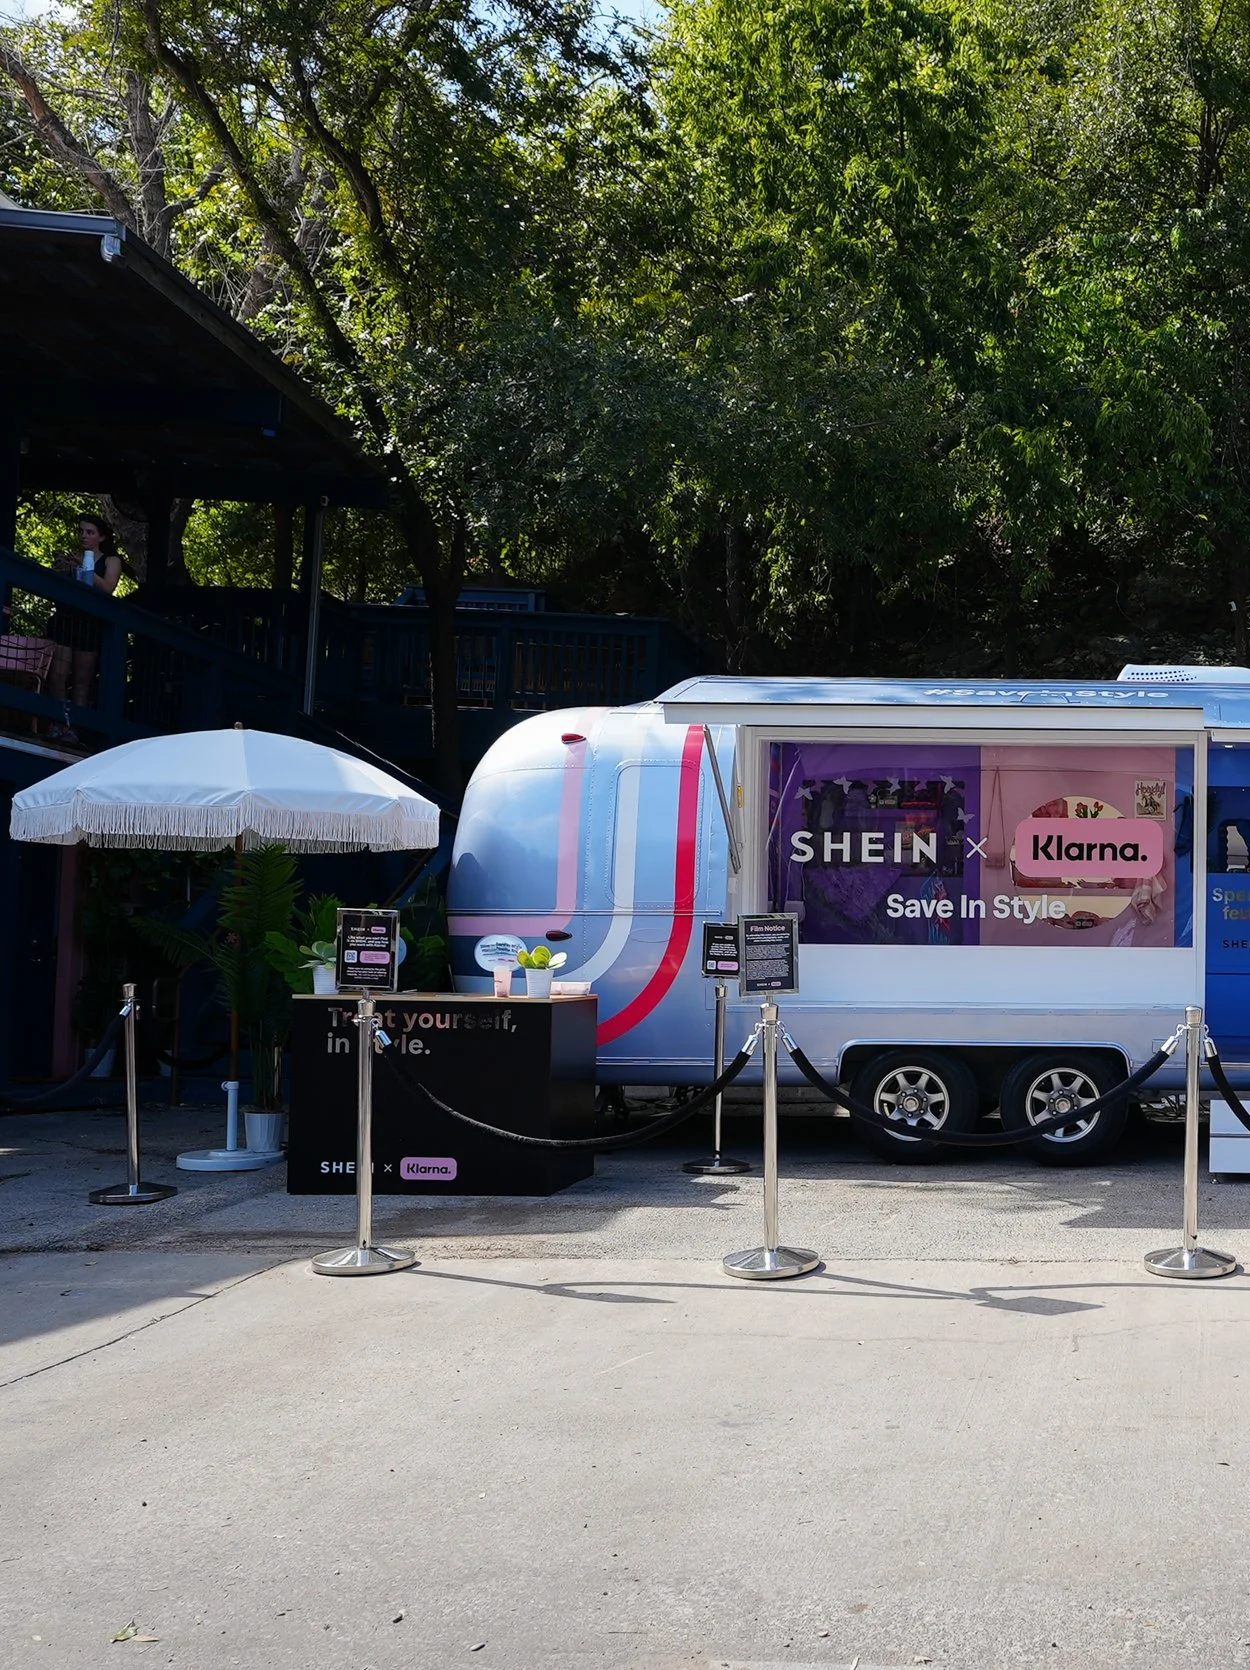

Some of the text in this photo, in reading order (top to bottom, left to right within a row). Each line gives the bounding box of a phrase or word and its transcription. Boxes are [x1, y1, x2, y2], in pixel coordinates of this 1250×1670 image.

[790, 831, 937, 863] SHEIN
[1032, 834, 1148, 862] Klarna.
[886, 894, 1067, 925] Save In Style
[403, 1005, 517, 1032] yourself,
[327, 1032, 350, 1053] in
[320, 1161, 374, 1174] SHE
[406, 1162, 452, 1176] Klarna.
